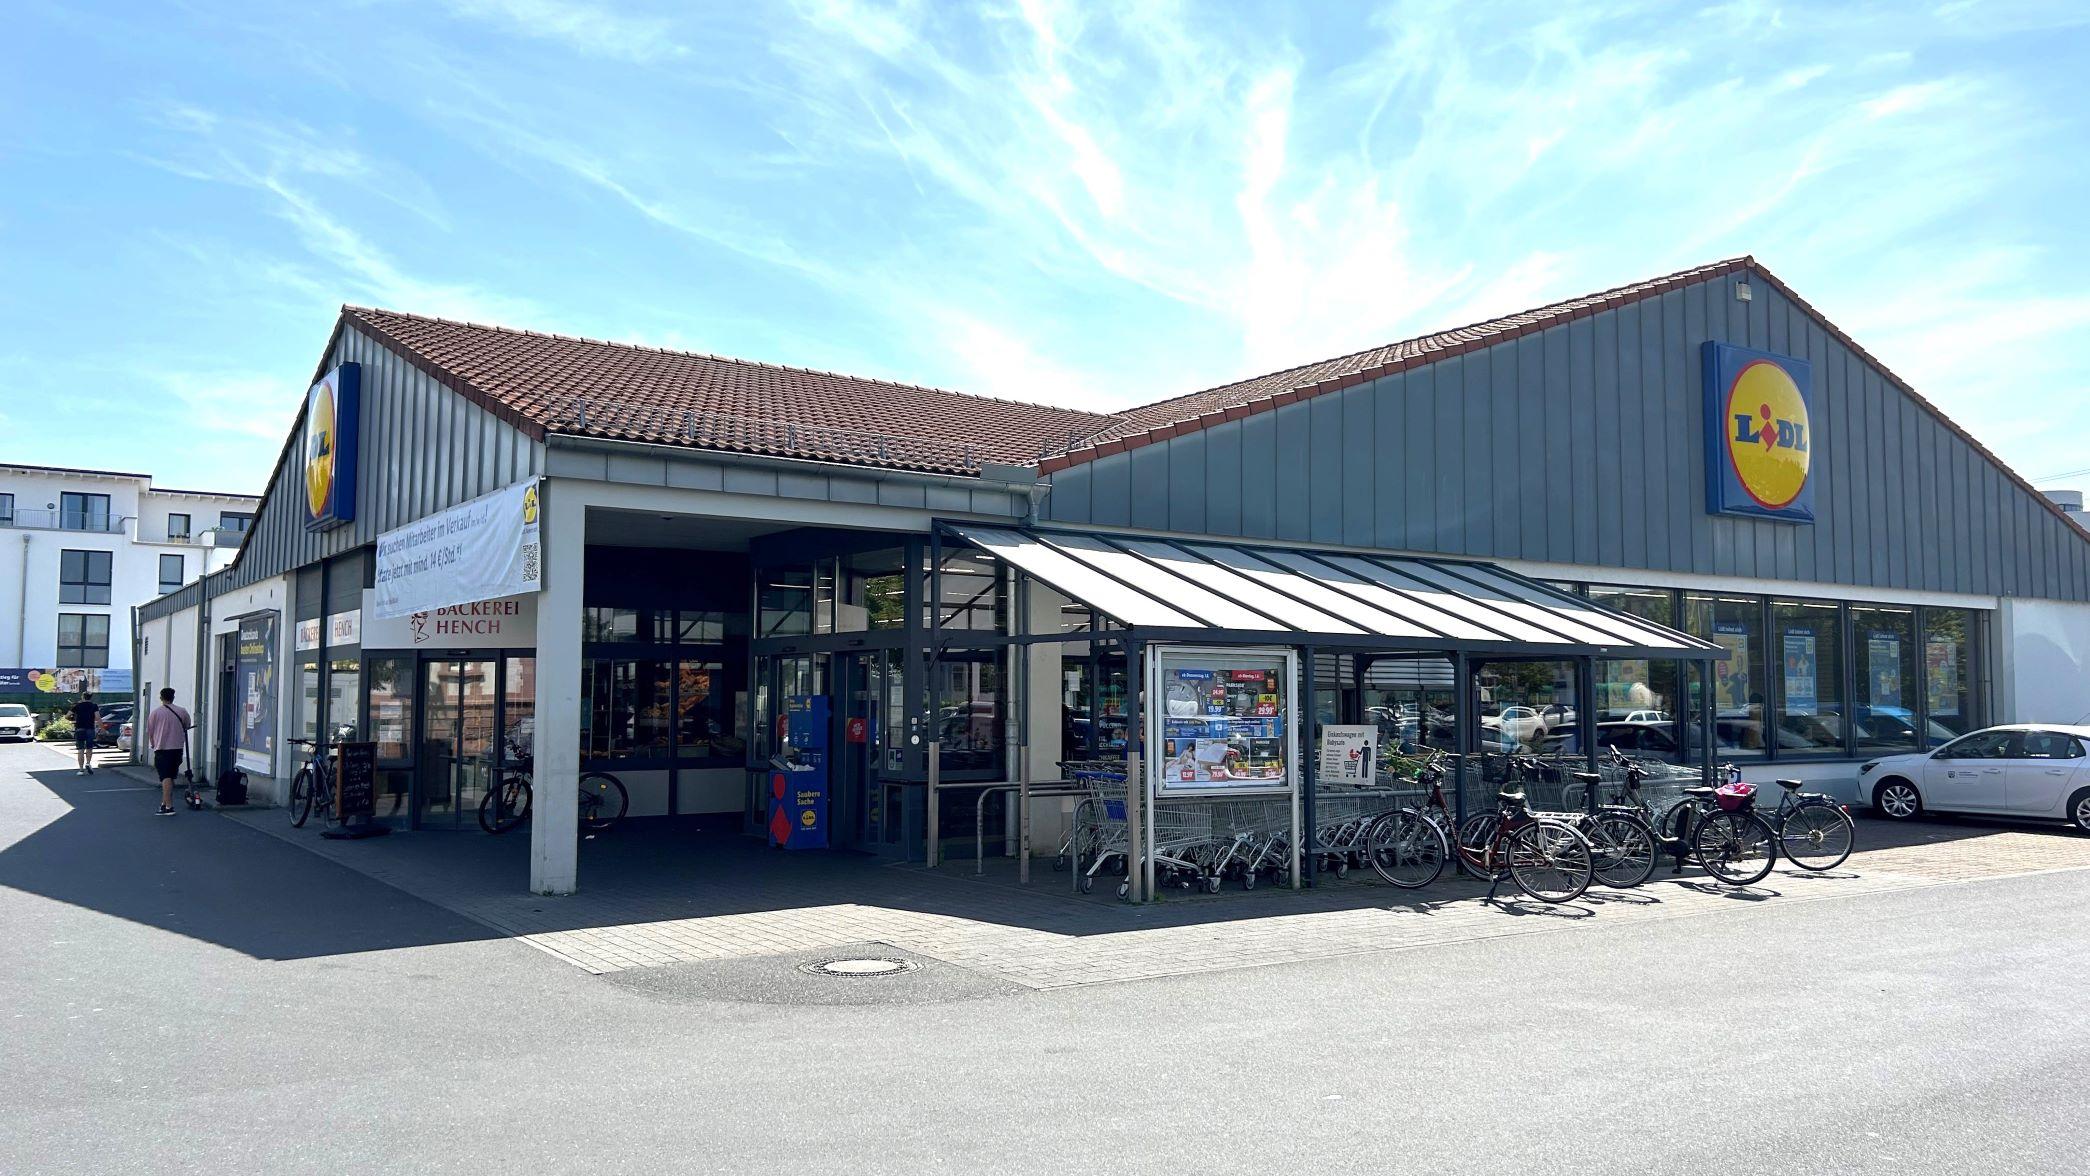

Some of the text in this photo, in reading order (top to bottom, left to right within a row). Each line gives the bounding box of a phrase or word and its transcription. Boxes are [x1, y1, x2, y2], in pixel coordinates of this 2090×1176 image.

[387, 535, 406, 556] suchen
[406, 524, 438, 550] Mitarbeiter
[437, 520, 445, 539] im
[446, 509, 471, 535] Verkauf
[391, 562, 403, 584] jetzt
[403, 561, 413, 577] mit
[413, 555, 428, 575] mind.
[430, 551, 437, 569] 14
[334, 619, 352, 637] HENCH
[436, 619, 500, 634] HENCH
[797, 790, 821, 798] Saubere
[797, 798, 815, 806] Sache
